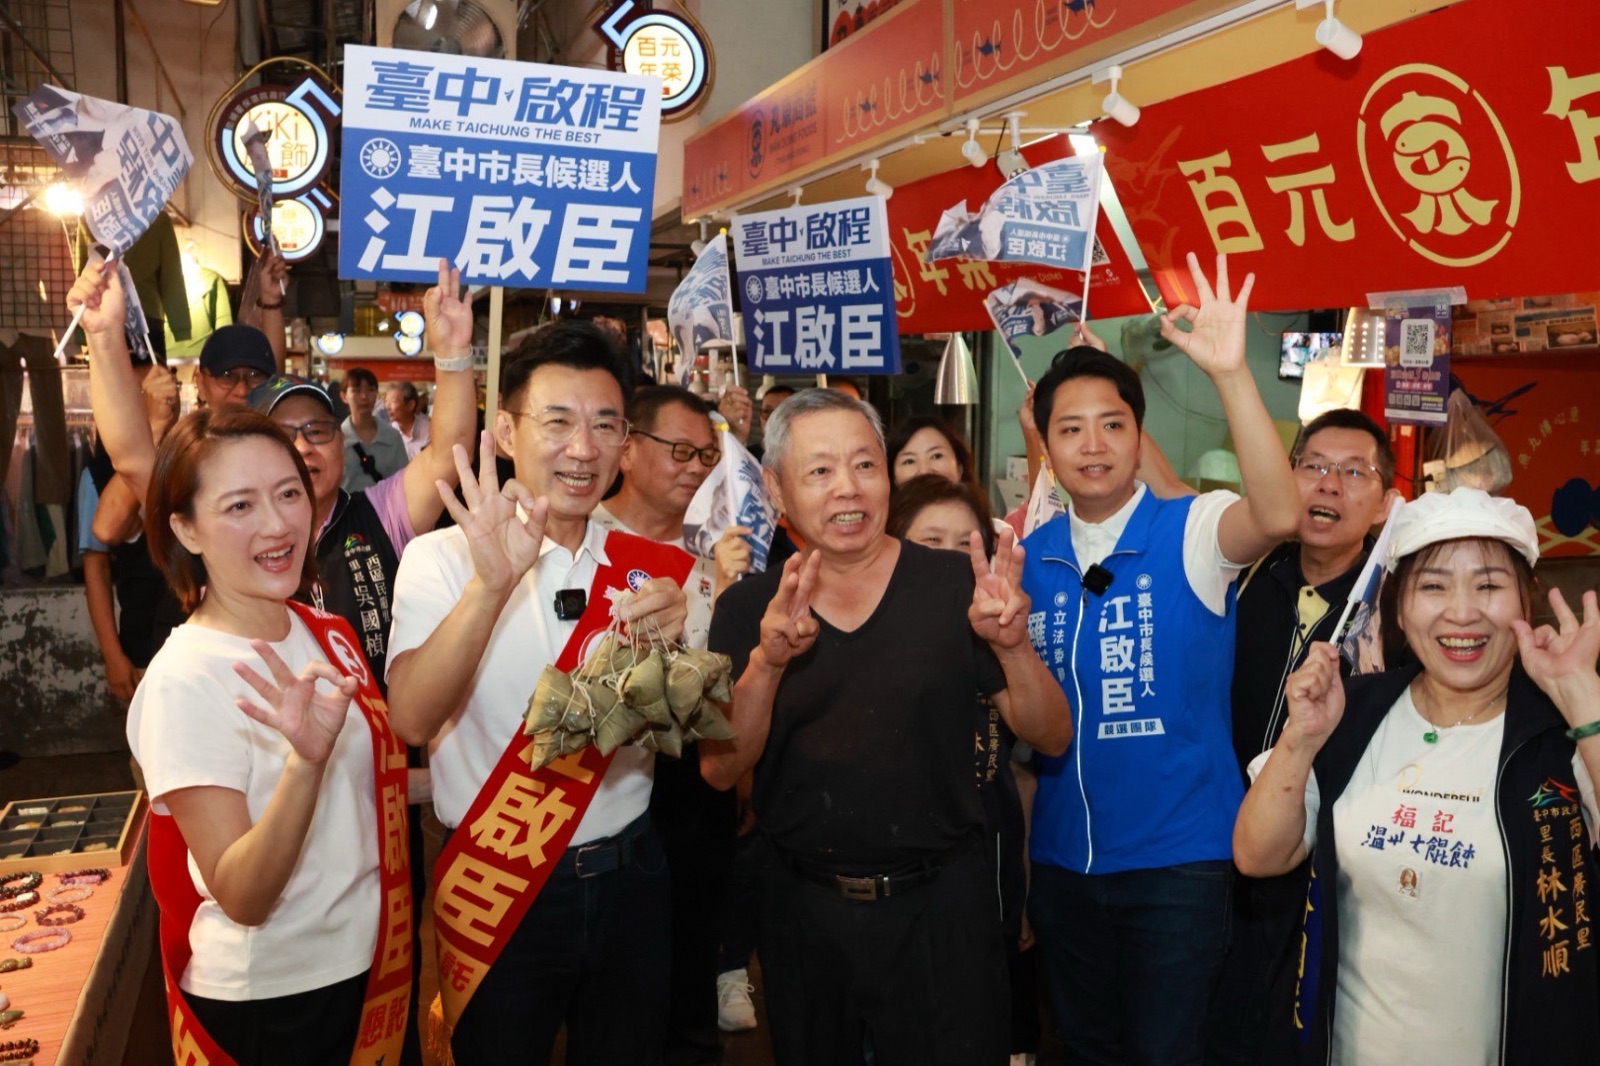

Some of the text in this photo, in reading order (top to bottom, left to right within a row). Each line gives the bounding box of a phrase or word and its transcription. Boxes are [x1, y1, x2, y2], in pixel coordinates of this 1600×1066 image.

[636, 36, 681, 56] 百元
[409, 117, 602, 144] MAKE TAICHUNG THE BEST
[407, 144, 642, 195] 臺中市長候選人
[1177, 132, 1355, 254] 百元
[357, 186, 642, 284] 江啟臣
[762, 249, 852, 266] MAKE TAICHUNG THE BEST
[764, 267, 880, 300] 臺中市長候選人
[753, 303, 884, 369] 江啟臣
[1098, 595, 1136, 715] 江啟臣
[1137, 593, 1155, 698] 臺中市長候選人
[1104, 721, 1157, 735] 競選團隊
[1391, 804, 1454, 834] 福記
